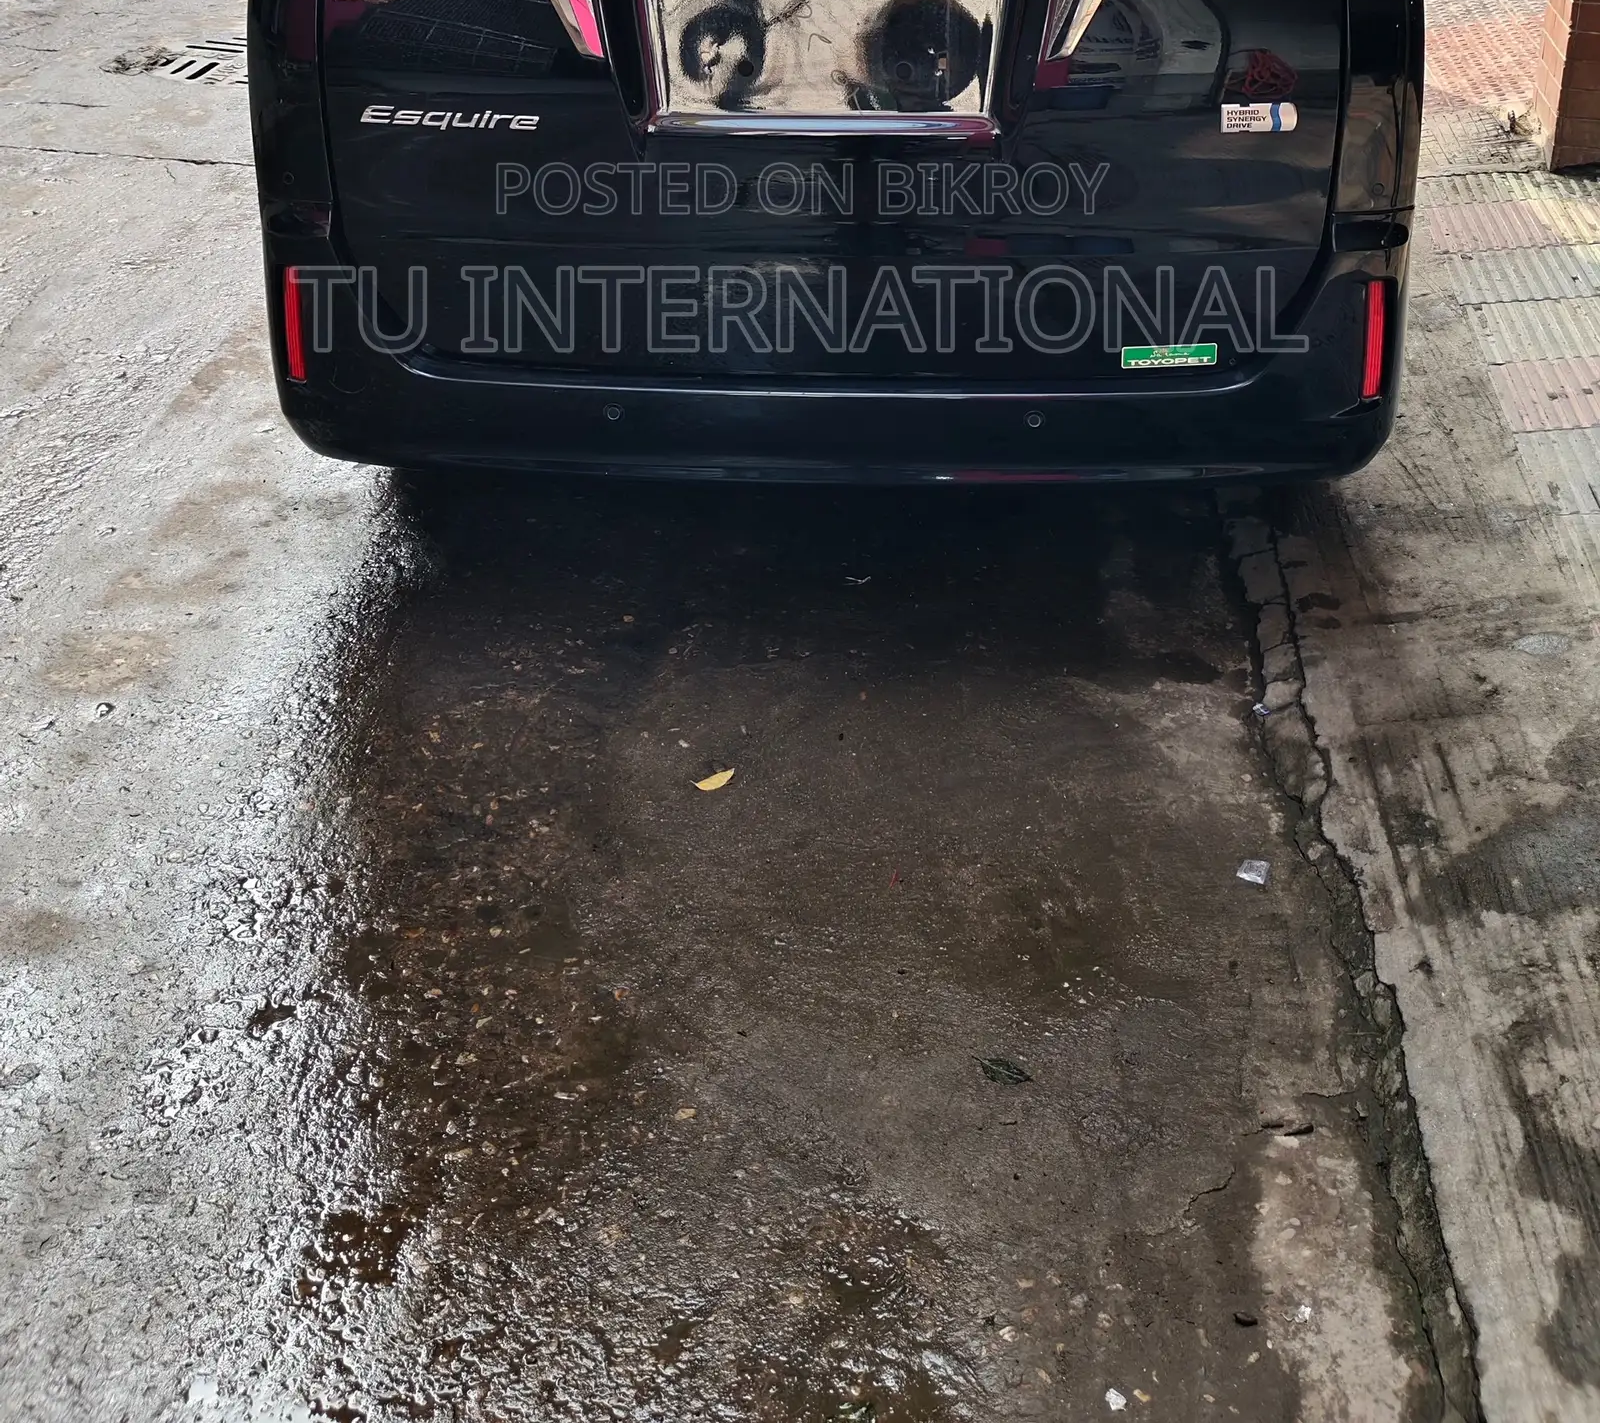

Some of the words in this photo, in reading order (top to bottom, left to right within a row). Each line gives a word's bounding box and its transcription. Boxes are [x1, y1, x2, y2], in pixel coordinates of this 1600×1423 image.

[360, 104, 541, 131] Esquire
[1226, 115, 1268, 123] SYNERGY
[1127, 356, 1212, 367] TOYOPET
